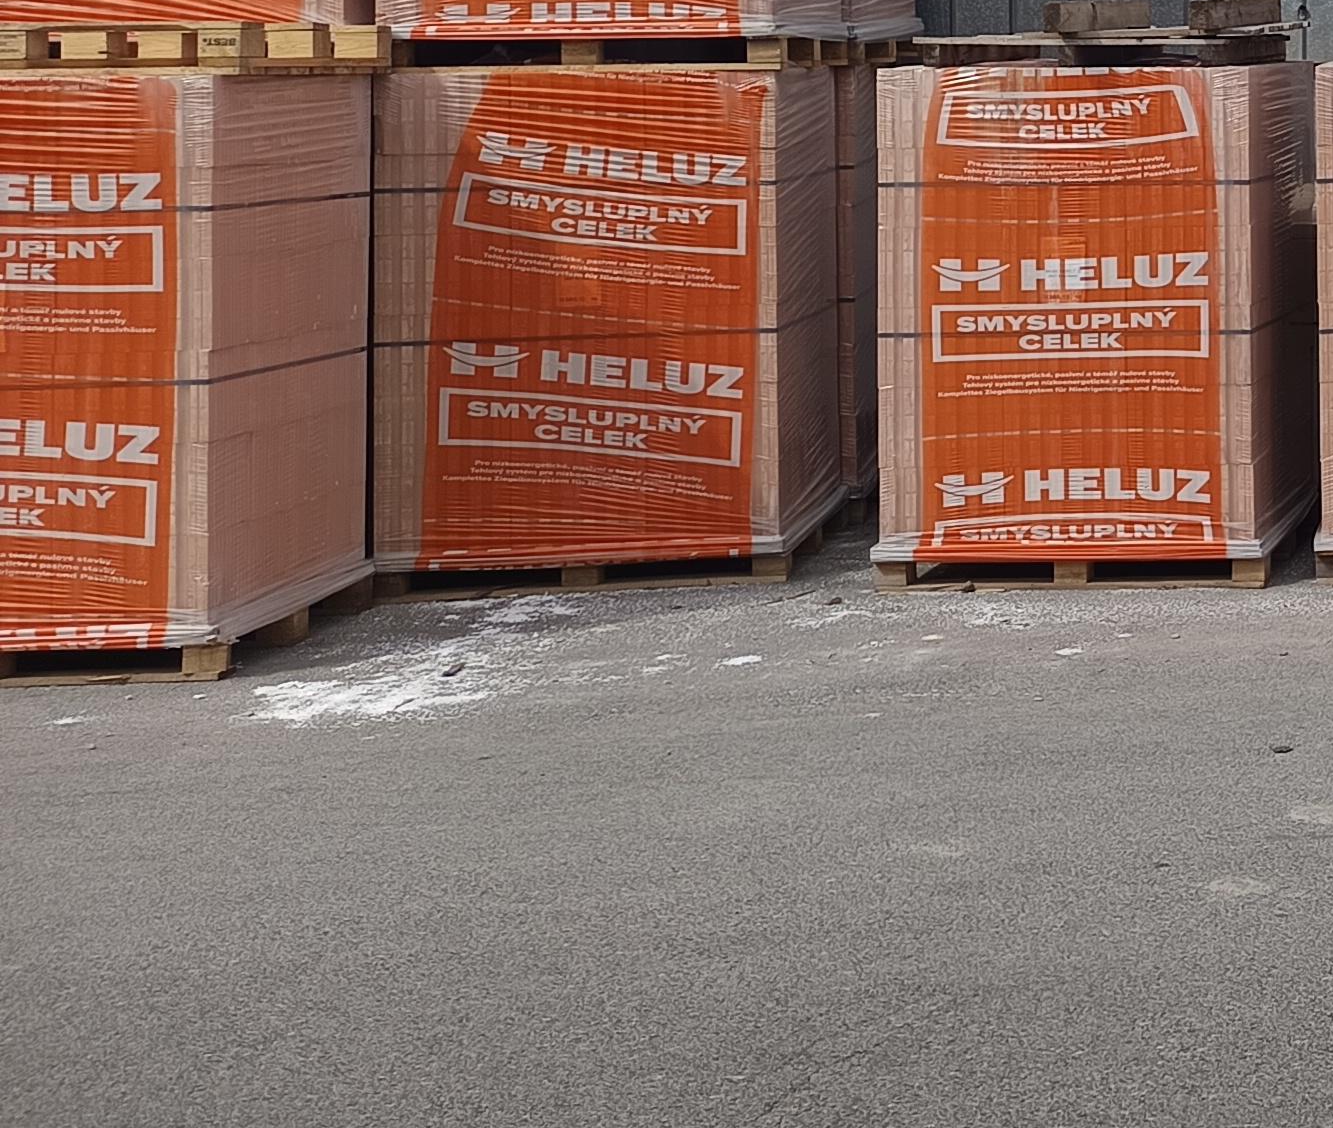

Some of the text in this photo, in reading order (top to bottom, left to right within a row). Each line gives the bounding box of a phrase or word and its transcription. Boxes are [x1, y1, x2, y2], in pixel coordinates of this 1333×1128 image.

[966, 94, 1151, 121] SMYSLUPLNÝ
[1018, 122, 1106, 141] CELEK
[563, 142, 748, 187] HELUZ
[0, 172, 163, 213] ELUZ
[487, 189, 713, 225] SMYSLUPLNÝ
[551, 217, 658, 242] CELEK
[1020, 252, 1209, 291] HELUZ
[955, 307, 1177, 333] SMYSLUPLNÝ
[1018, 331, 1123, 350] CELEK
[540, 349, 745, 399] HELUZ
[466, 399, 707, 435] SMYSLUPLNÝ
[0, 419, 160, 465] ELUZ
[534, 423, 648, 449] CELEK
[1024, 468, 1211, 504] HELUZ
